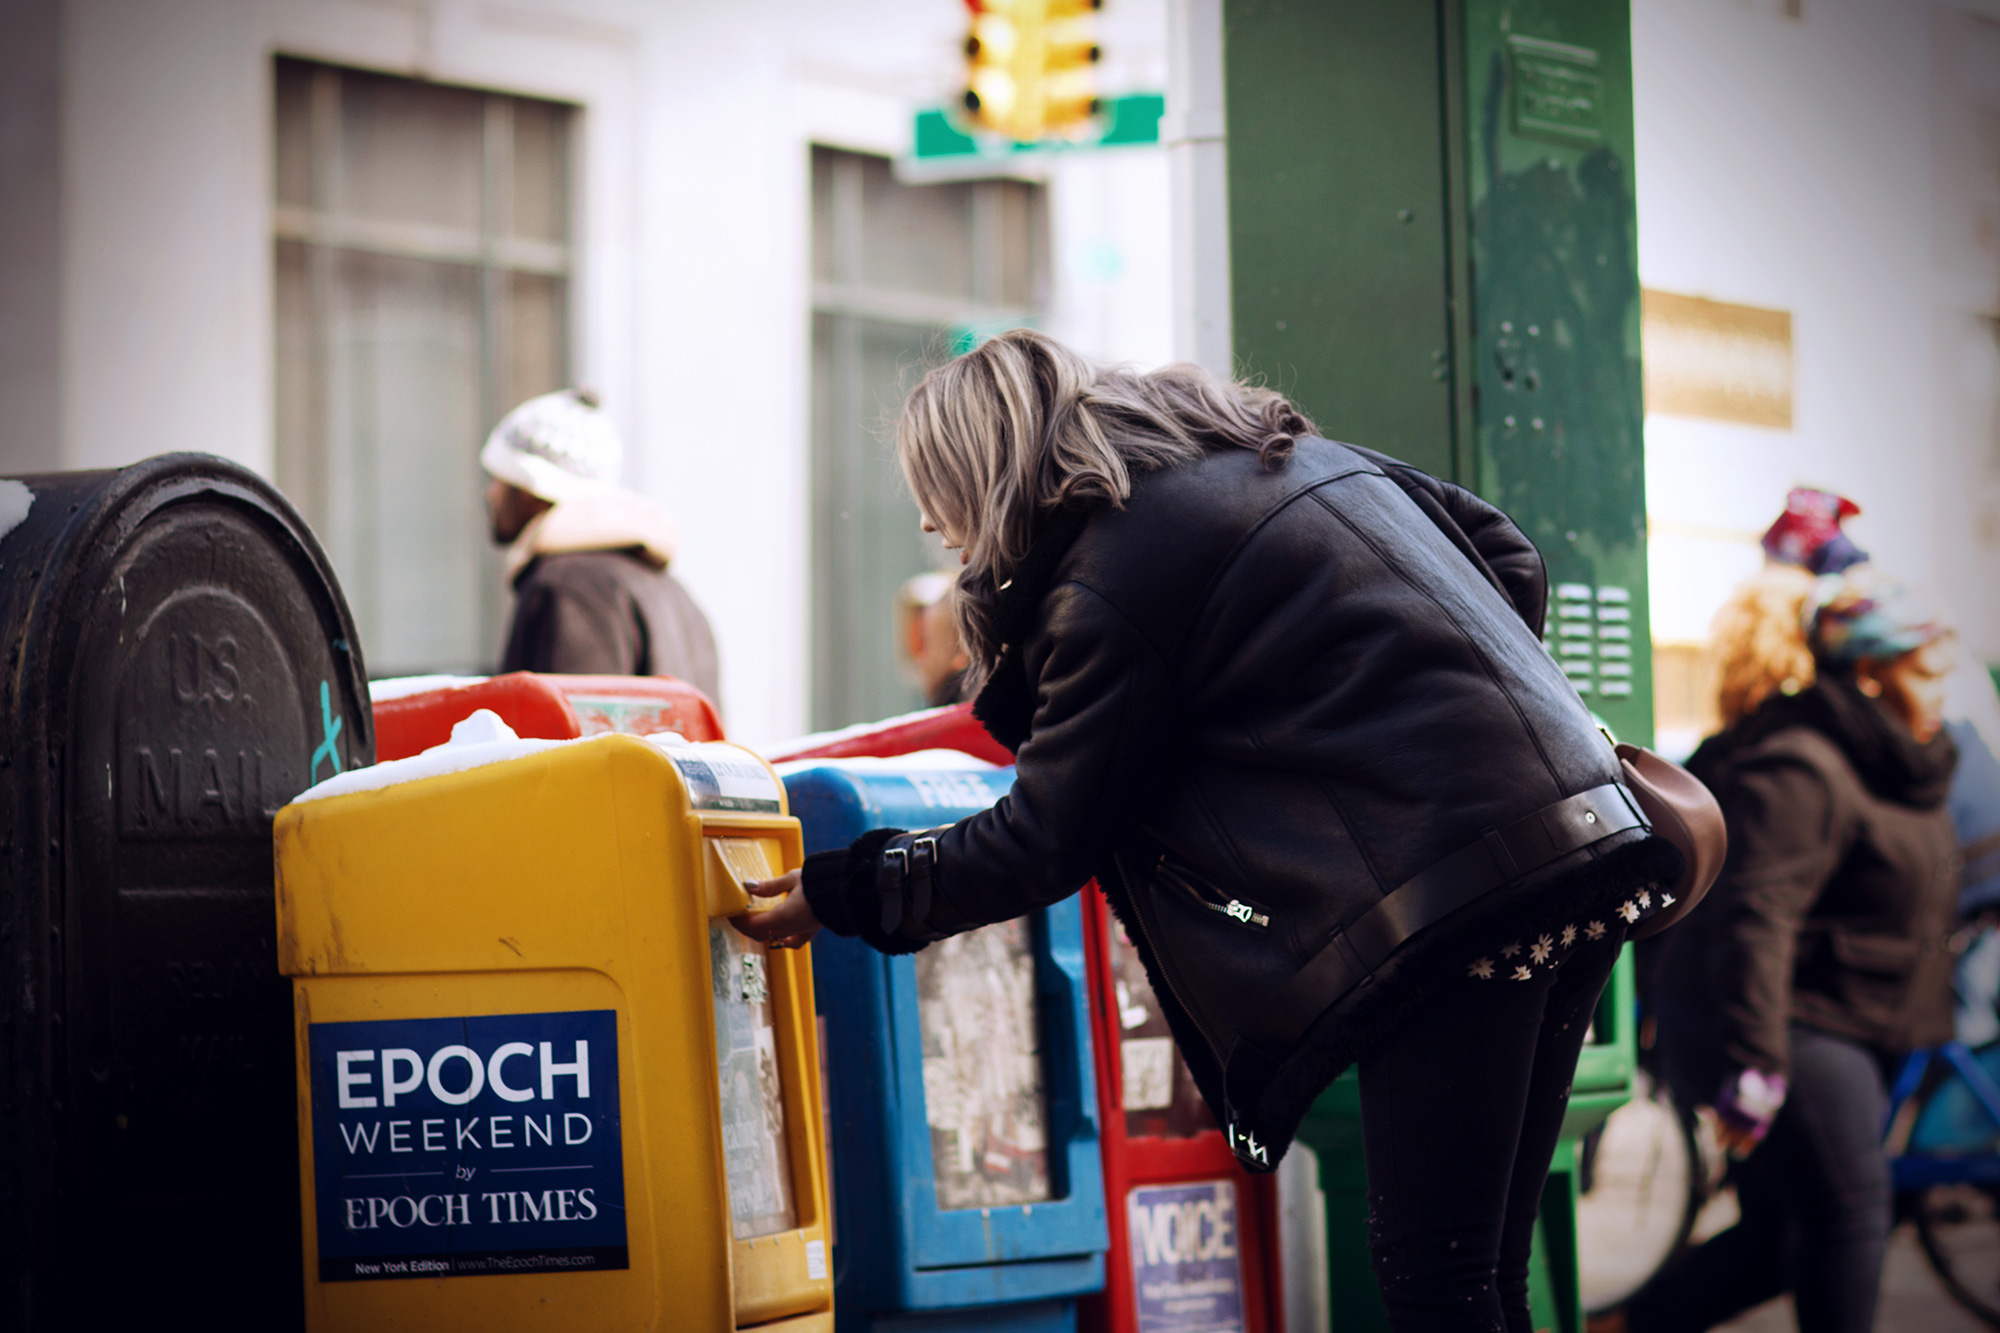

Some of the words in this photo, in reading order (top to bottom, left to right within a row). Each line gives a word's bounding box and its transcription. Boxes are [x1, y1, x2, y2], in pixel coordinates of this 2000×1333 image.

[137, 748, 277, 825] MAIL
[905, 773, 1000, 808] FREE
[337, 1039, 591, 1109] EPOCH
[339, 1112, 593, 1155] WEEKEND
[456, 1164, 476, 1182] by
[345, 1193, 472, 1230] EPOCH
[481, 1188, 598, 1224] TIMES
[1137, 1199, 1237, 1265] VOICE
[354, 1262, 381, 1274] New
[383, 1261, 408, 1273] York
[410, 1259, 450, 1272] Edition
[456, 1253, 597, 1270] www.TheEpochTimes.com
